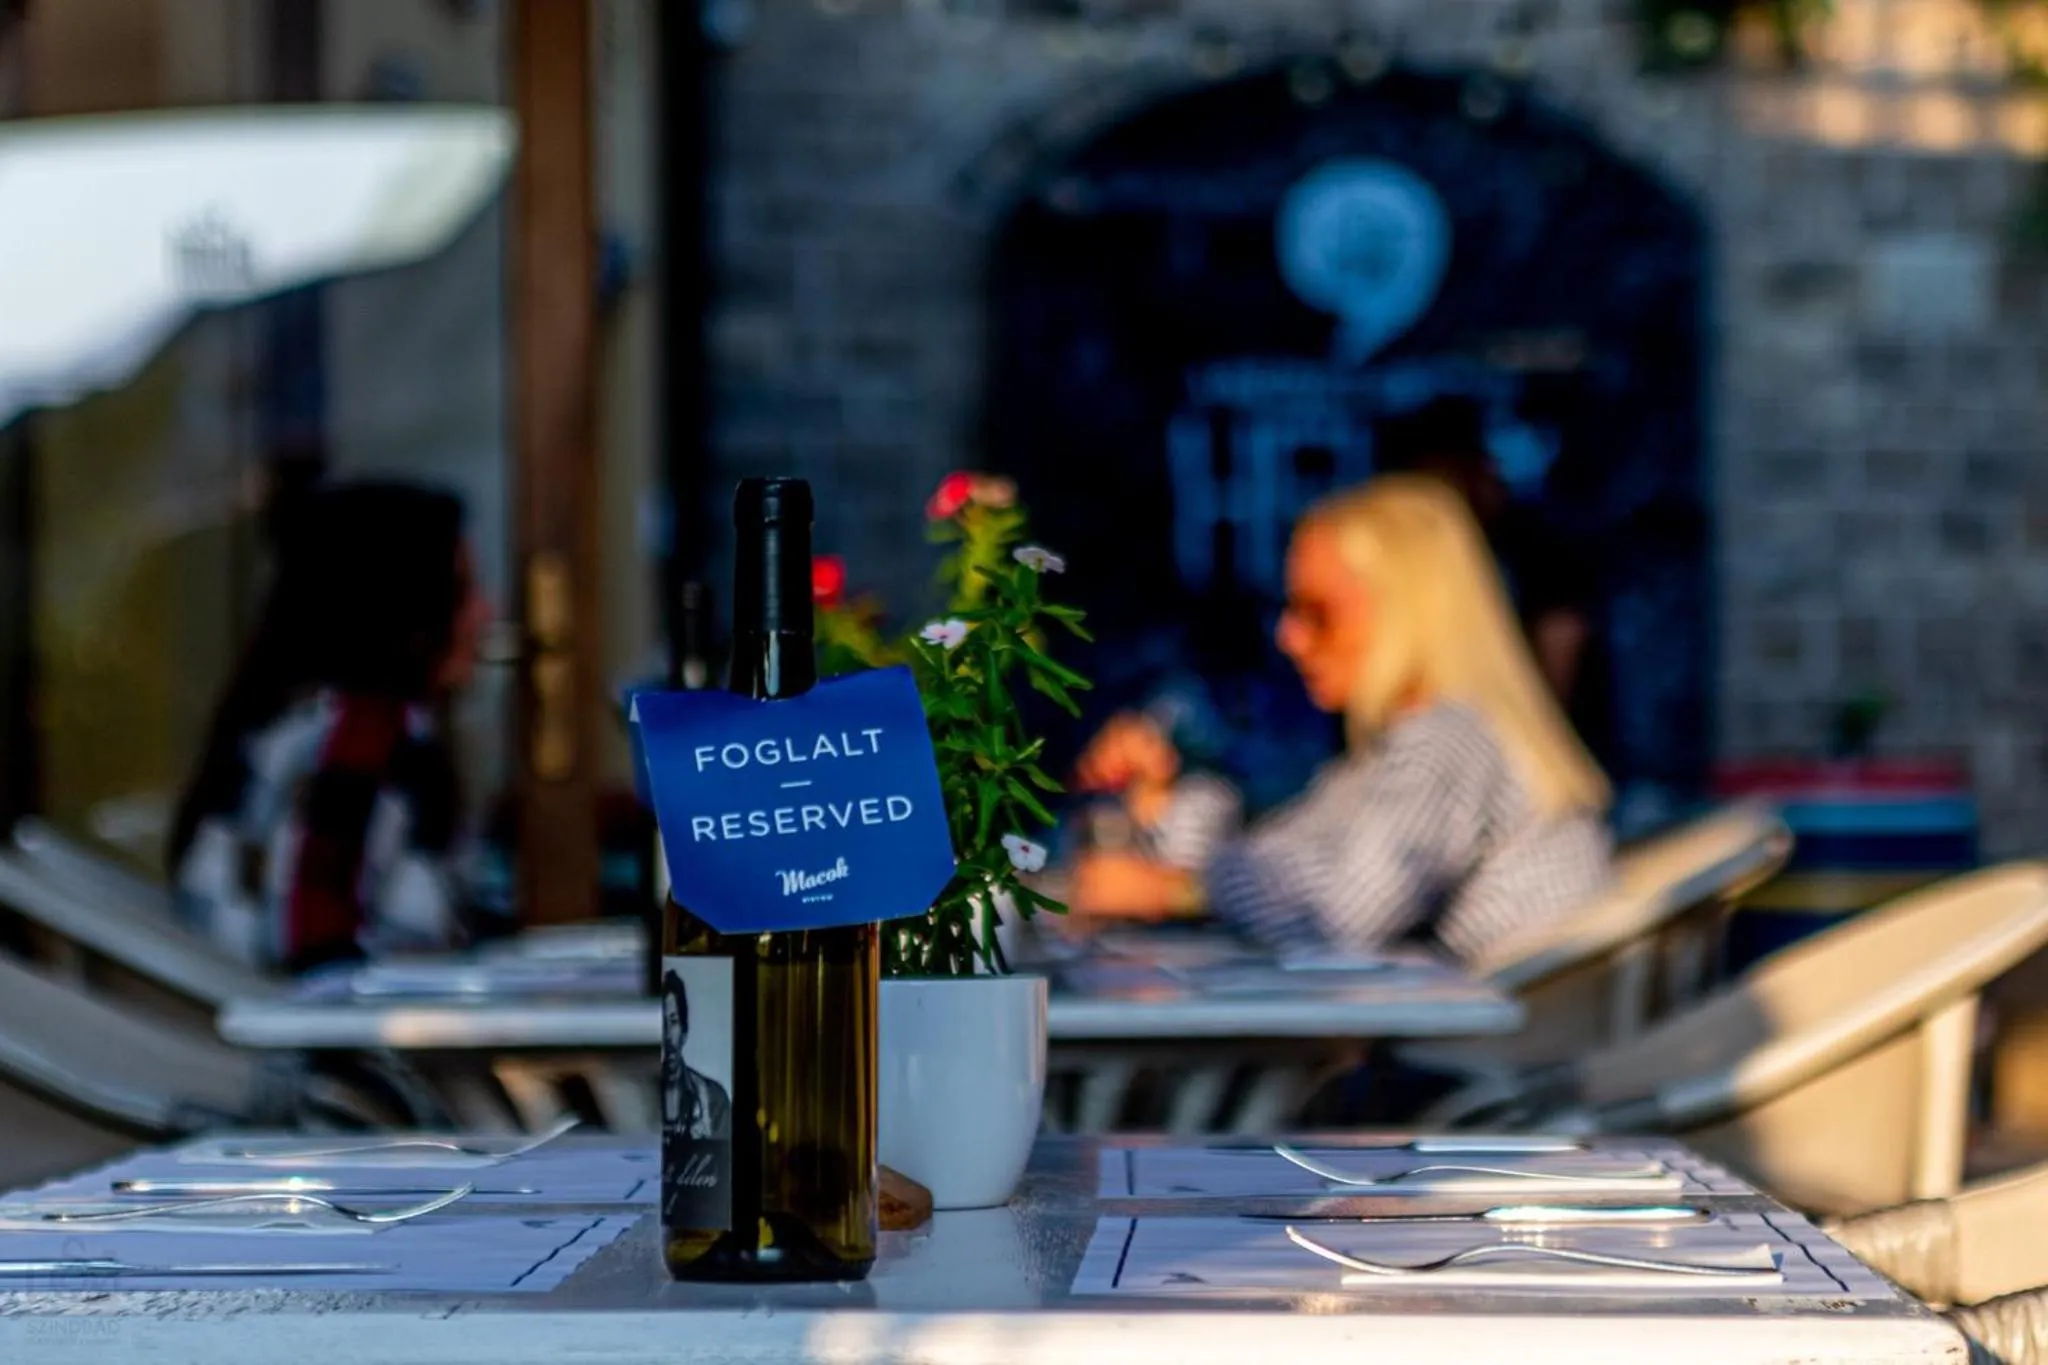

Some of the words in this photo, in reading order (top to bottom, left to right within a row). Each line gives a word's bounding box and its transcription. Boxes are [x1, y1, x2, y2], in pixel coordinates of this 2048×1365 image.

[694, 729, 884, 773] FOGLALT
[691, 795, 914, 842] RESERVED
[775, 856, 849, 896] Macok
